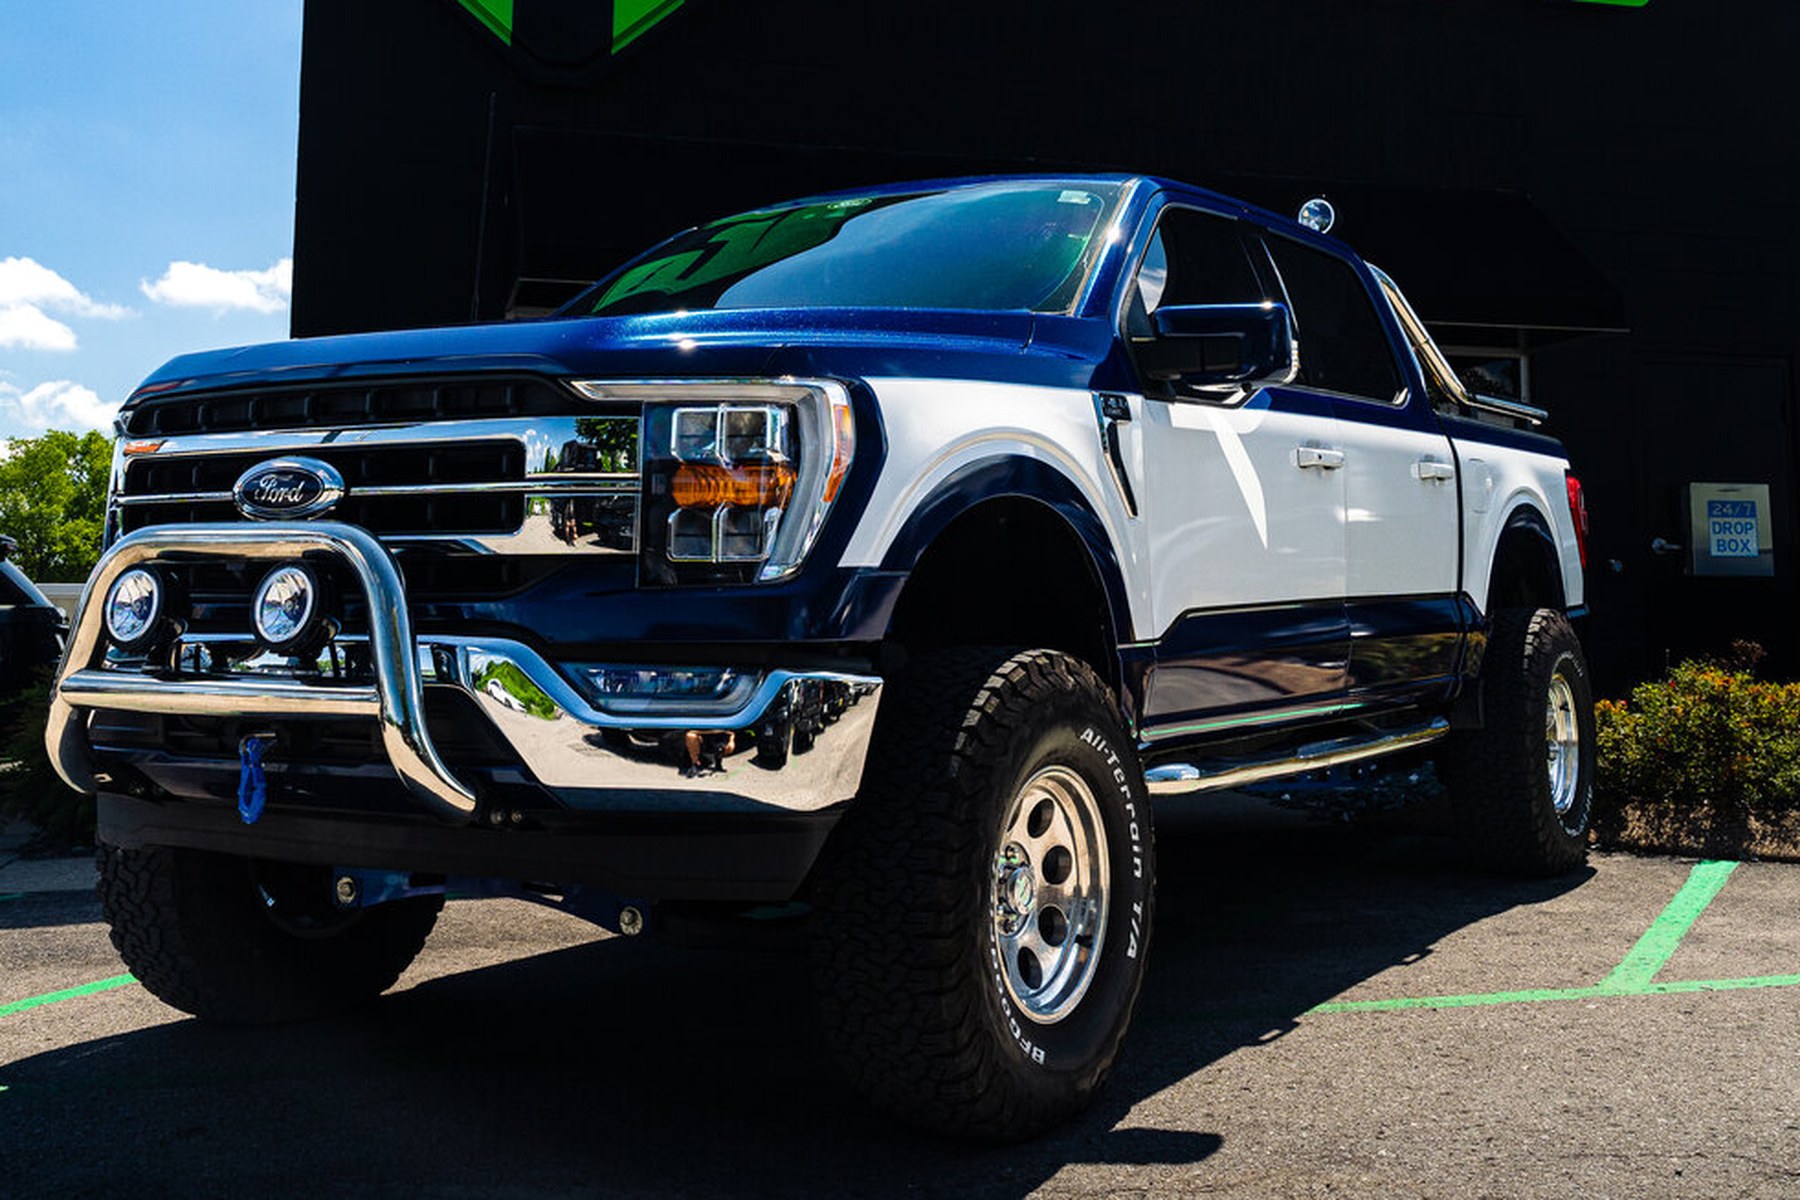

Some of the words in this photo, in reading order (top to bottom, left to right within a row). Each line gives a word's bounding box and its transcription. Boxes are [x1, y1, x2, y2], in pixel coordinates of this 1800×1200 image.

[254, 474, 306, 503] Ford
[1711, 503, 1752, 516] 24/7
[1712, 521, 1754, 535] DROP
[1716, 538, 1751, 553] BOX
[1080, 727, 1143, 879] All-Terrain
[1126, 901, 1143, 959] T/A
